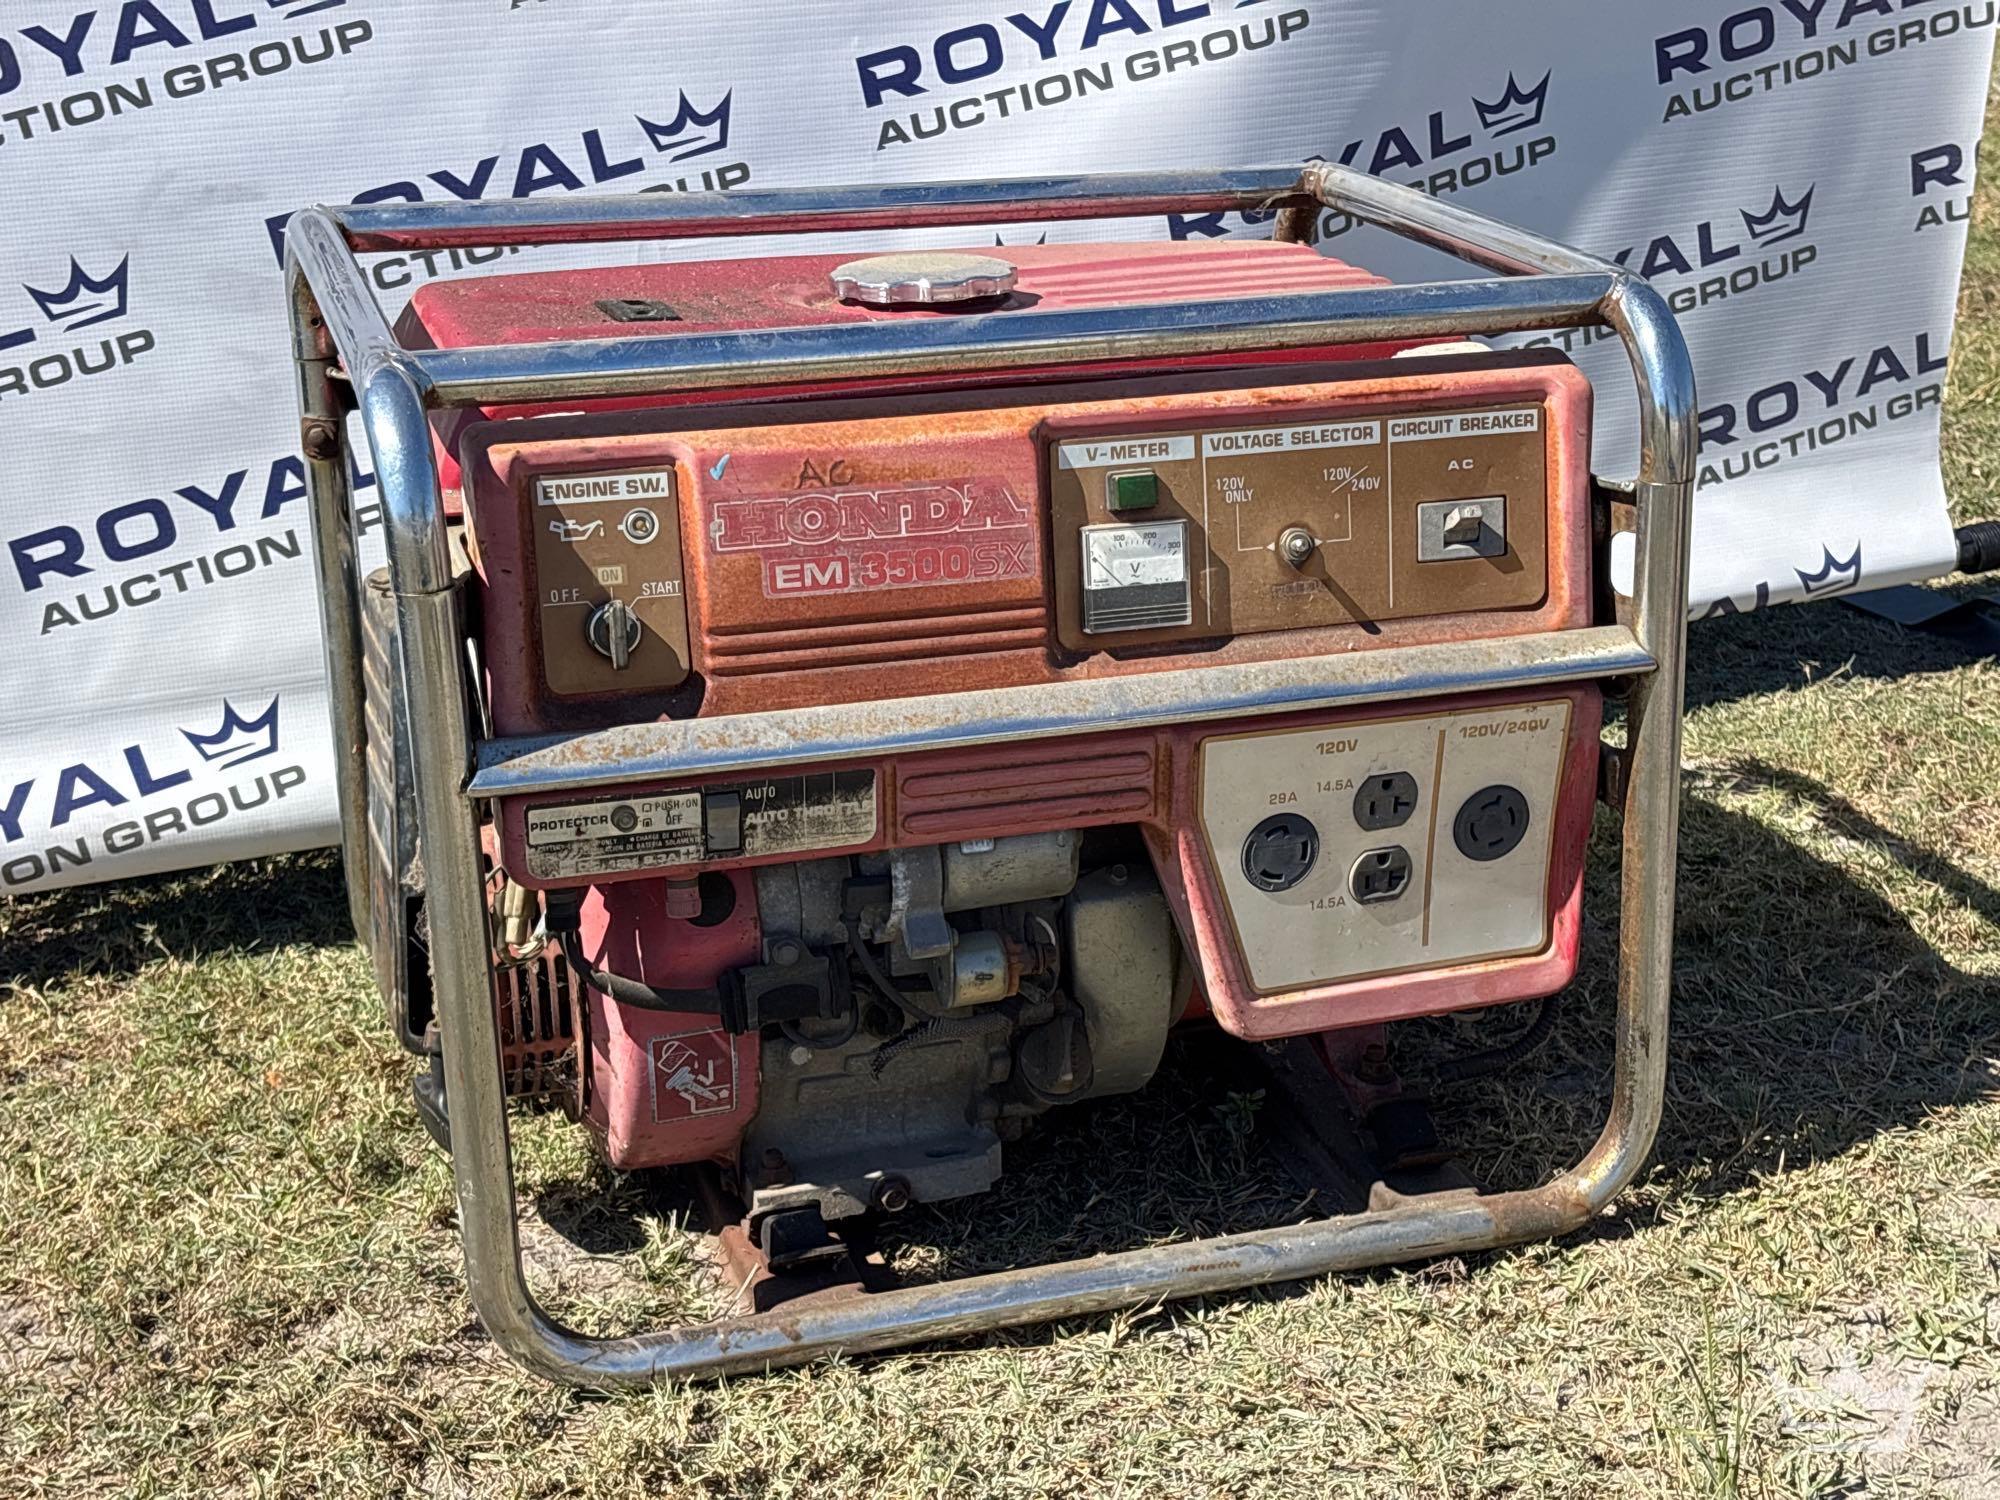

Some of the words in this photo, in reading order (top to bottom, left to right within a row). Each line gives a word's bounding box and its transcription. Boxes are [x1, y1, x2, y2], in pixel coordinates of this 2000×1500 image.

[1662, 39, 1856, 123] AUCTION
[1868, 2, 2000, 57] GROU
[0, 77, 153, 147] TION
[163, 20, 374, 99] GROUP
[877, 62, 1113, 150] AUCTION
[1125, 9, 1309, 82] GROUP
[1669, 245, 1816, 315] GROUP
[1391, 419, 1454, 438] CIRCUIT
[1460, 413, 1535, 432] BREAKER
[1209, 433, 1284, 451] VOLTAGE
[1291, 426, 1374, 446] SELECTOR
[1696, 406, 1877, 491] AUCTION
[1448, 458, 1474, 471] AC
[543, 480, 620, 500] ENGINE
[626, 478, 666, 495] SW.
[1216, 476, 1245, 491] 120V
[1225, 489, 1254, 504] ONLY
[711, 484, 1029, 551] HONDA
[40, 529, 302, 636] AUCTION
[601, 569, 619, 582] ON
[775, 562, 844, 590] EM
[551, 588, 580, 603] OFF
[642, 580, 681, 596] START
[1459, 717, 1550, 739] 120V/240V
[1316, 739, 1359, 756] 120V
[745, 785, 776, 801] AUTO
[1316, 778, 1354, 794] 14.5A
[1269, 791, 1298, 806] 29A
[102, 765, 306, 854] GROUP
[745, 809, 789, 827] AUTO
[530, 814, 609, 833] PROTECTOR
[666, 814, 684, 825] OFF
[1309, 896, 1346, 912] 14.5A
